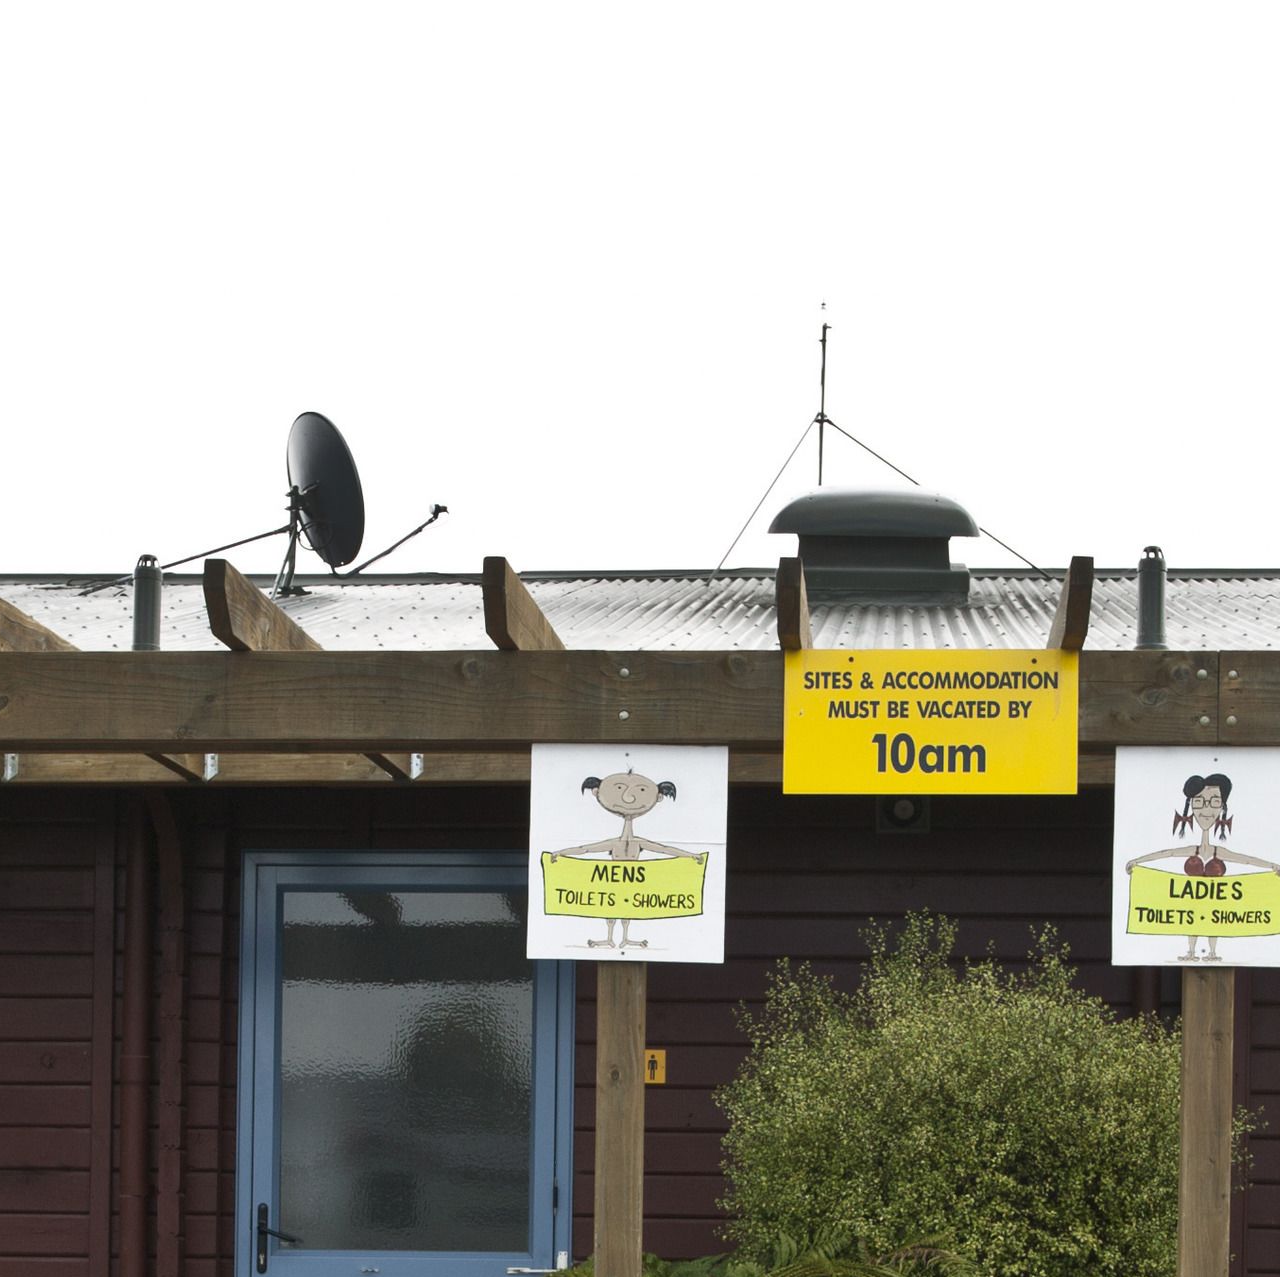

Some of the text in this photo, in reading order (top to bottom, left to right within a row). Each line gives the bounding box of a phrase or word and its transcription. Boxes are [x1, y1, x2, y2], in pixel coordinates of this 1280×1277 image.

[803, 671, 1059, 690] SITES & ACCOMMODATION
[828, 700, 1033, 719] MUST BE VACATED BY
[871, 732, 986, 774] 10am
[590, 864, 646, 883] MENS
[555, 888, 695, 909] TOILETS SHOWERS
[1169, 878, 1243, 900] LADIES
[1135, 906, 1271, 925] TOILETS SHOWERS
